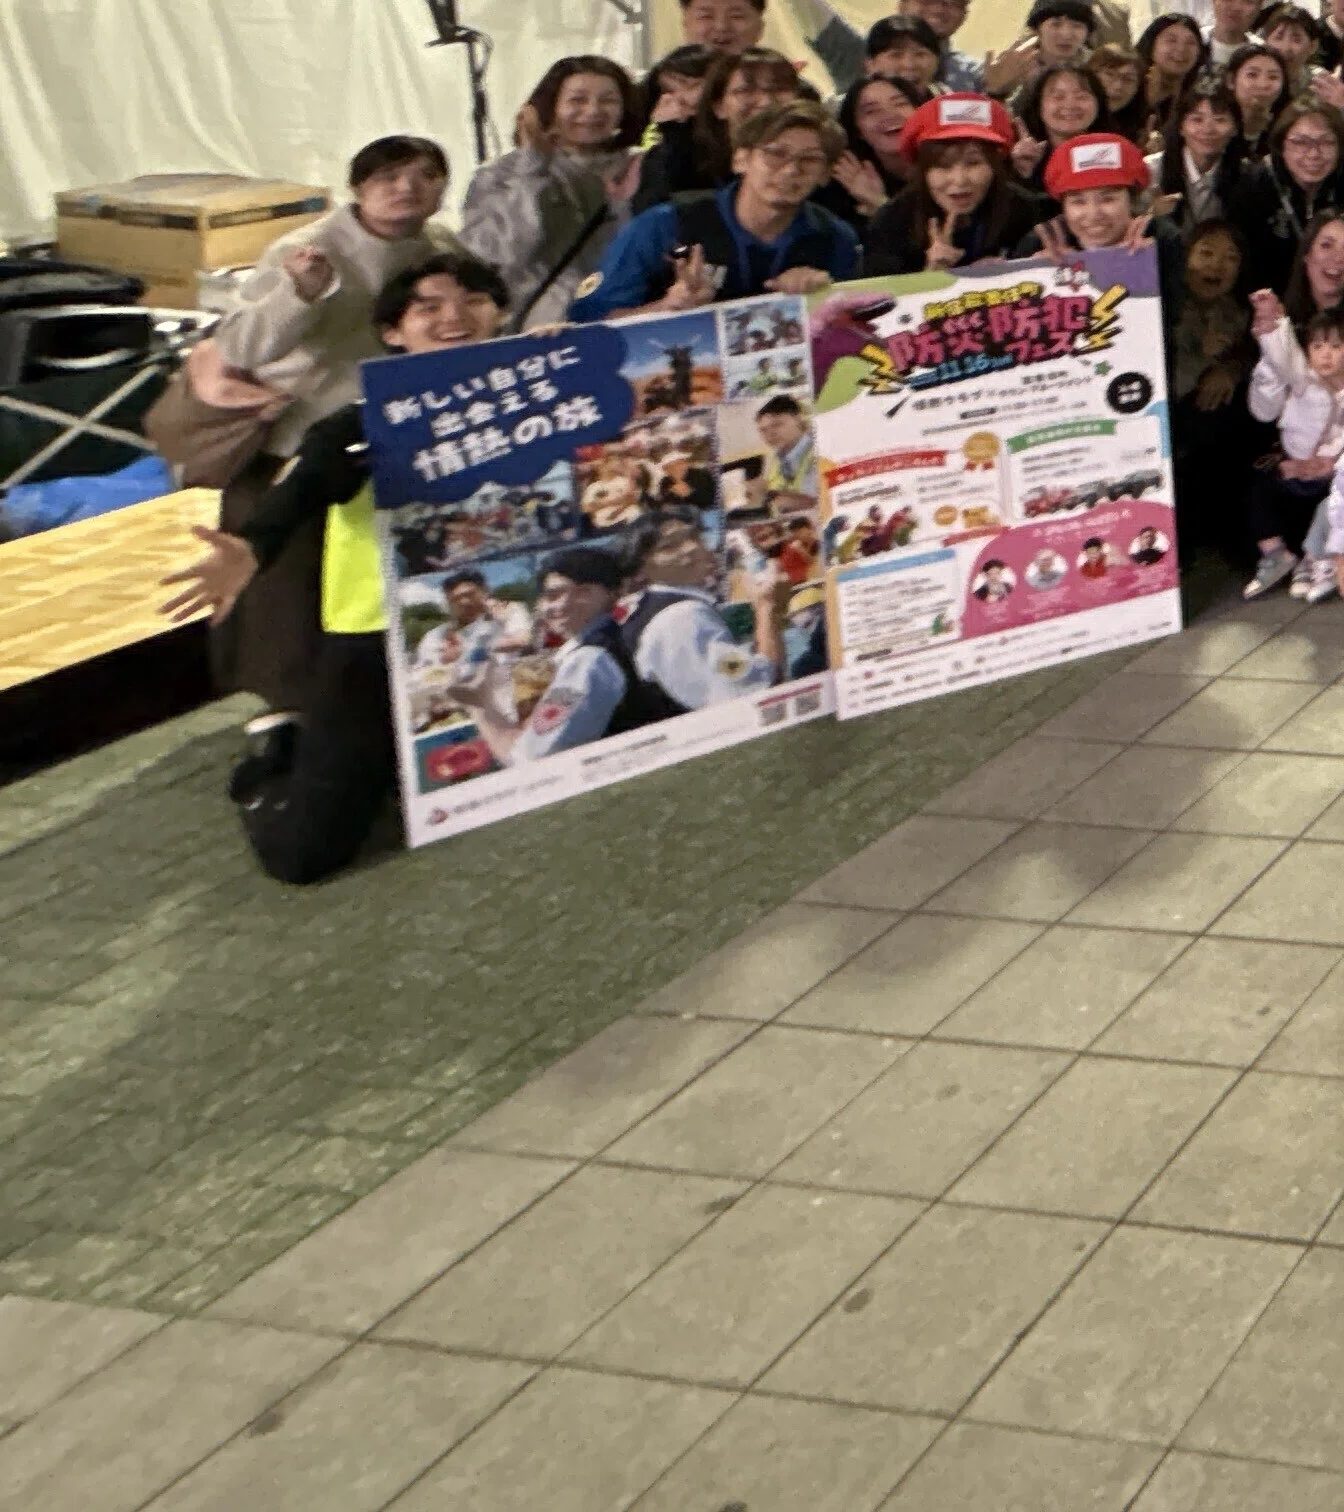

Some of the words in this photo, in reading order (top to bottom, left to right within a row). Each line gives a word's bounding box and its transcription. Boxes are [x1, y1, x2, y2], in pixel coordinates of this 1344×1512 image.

[1004, 330, 1077, 364] フェス
[382, 345, 584, 425] 新しい自分に
[430, 380, 560, 438] 出会える
[412, 395, 604, 482] 情熱の旅
